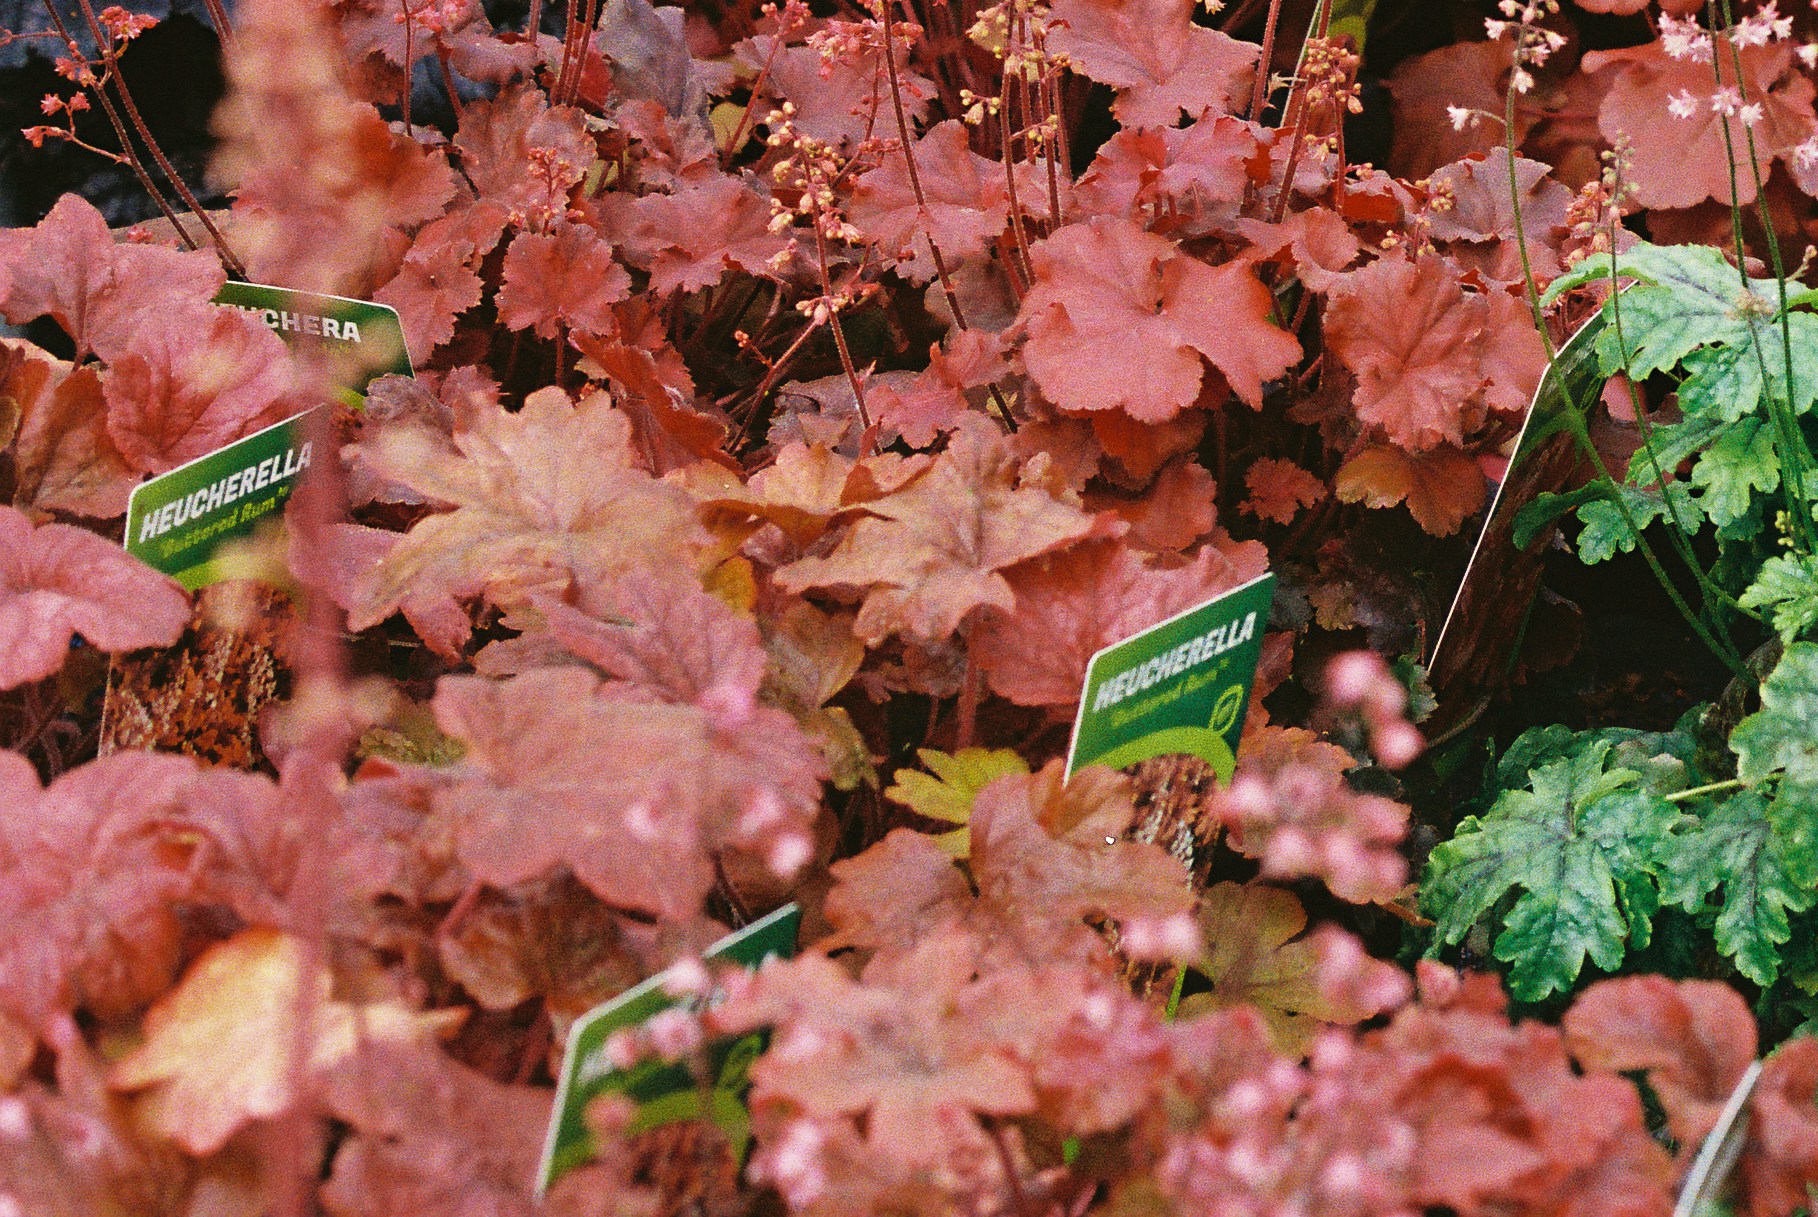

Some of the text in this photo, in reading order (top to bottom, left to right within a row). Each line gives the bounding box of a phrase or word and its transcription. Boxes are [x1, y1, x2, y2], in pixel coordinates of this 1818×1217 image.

[209, 301, 362, 343] CHERA
[138, 440, 313, 544] HEUCHERELLA
[1092, 611, 1257, 714] HEUCHERELLA
